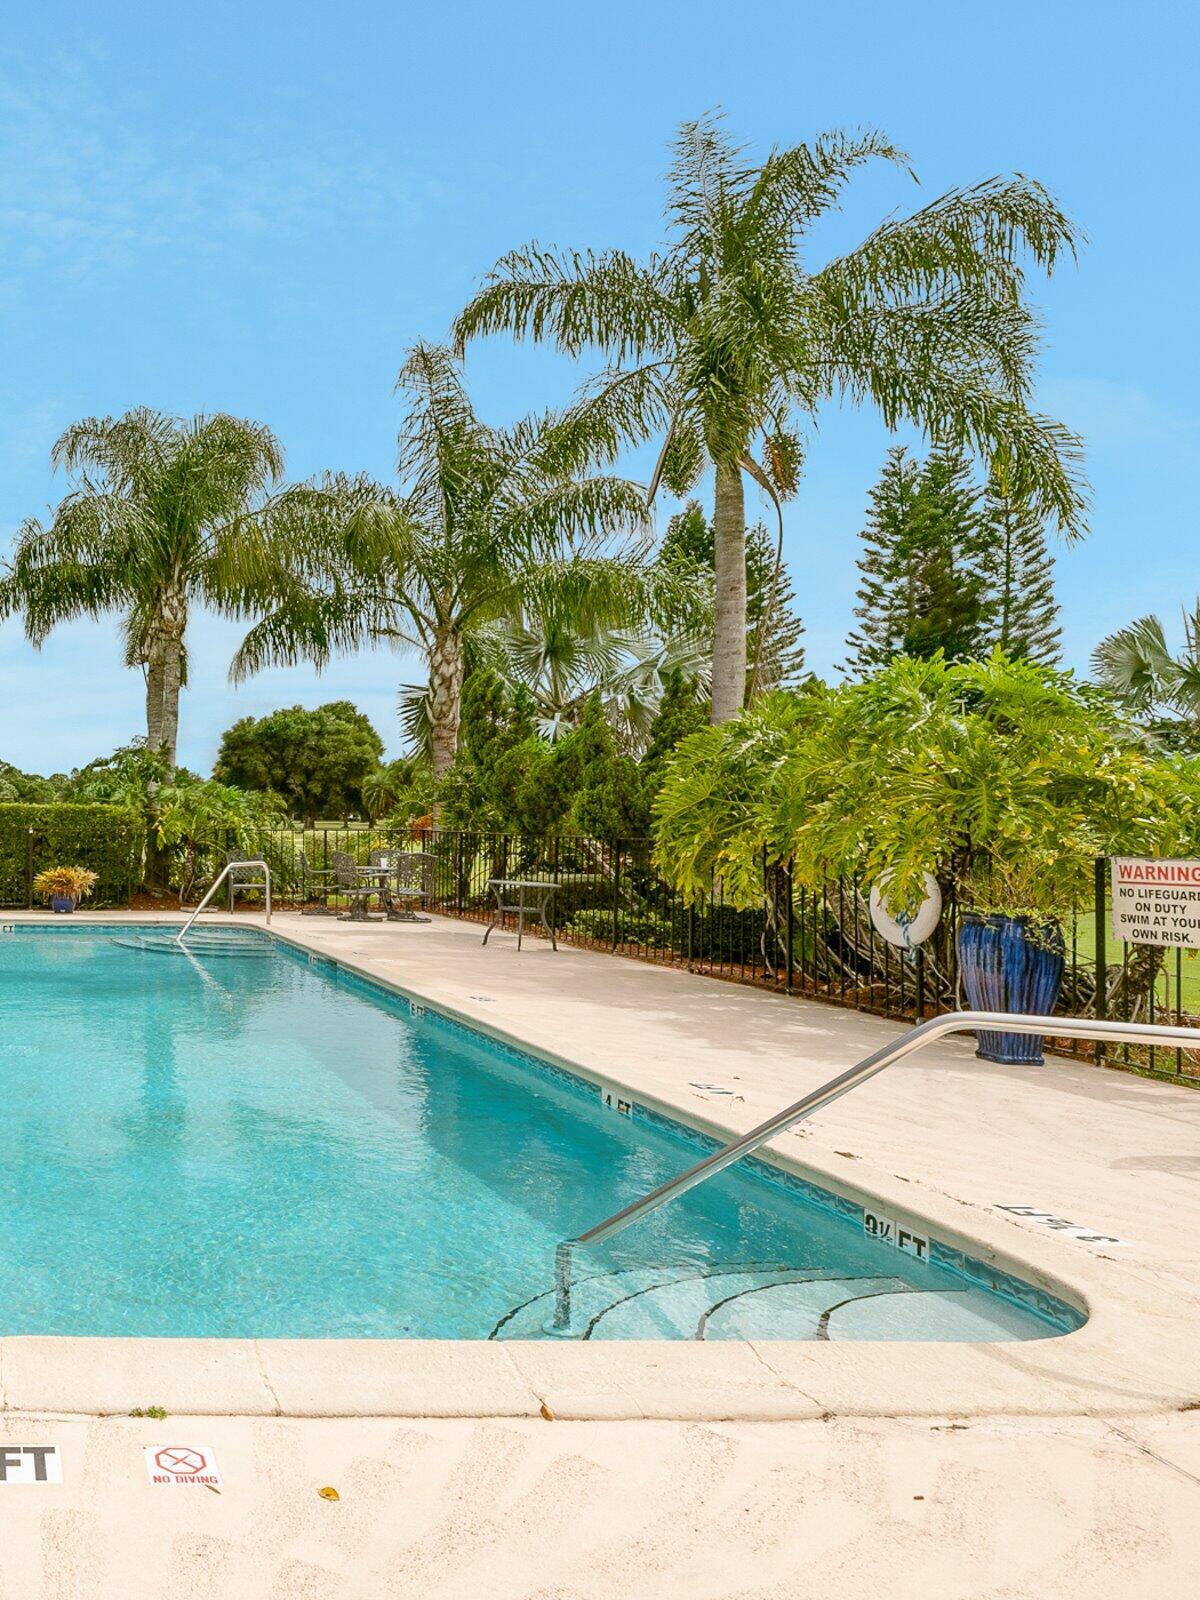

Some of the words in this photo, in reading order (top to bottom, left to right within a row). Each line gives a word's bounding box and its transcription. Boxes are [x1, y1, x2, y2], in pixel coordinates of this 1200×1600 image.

[1119, 865, 1200, 882] WARNING
[1119, 888, 1135, 898] NO
[1135, 902, 1151, 912] ON
[1154, 903, 1187, 914] DUTY
[1120, 914, 1150, 925] SWIM
[1153, 917, 1167, 926] AT
[1171, 917, 1200, 929] YOU
[1132, 929, 1158, 940] OWN
[1161, 931, 1194, 943] RISK.
[899, 1229, 927, 1258] FT
[153, 1475, 171, 1483] NO
[175, 1475, 218, 1484] DIVING
